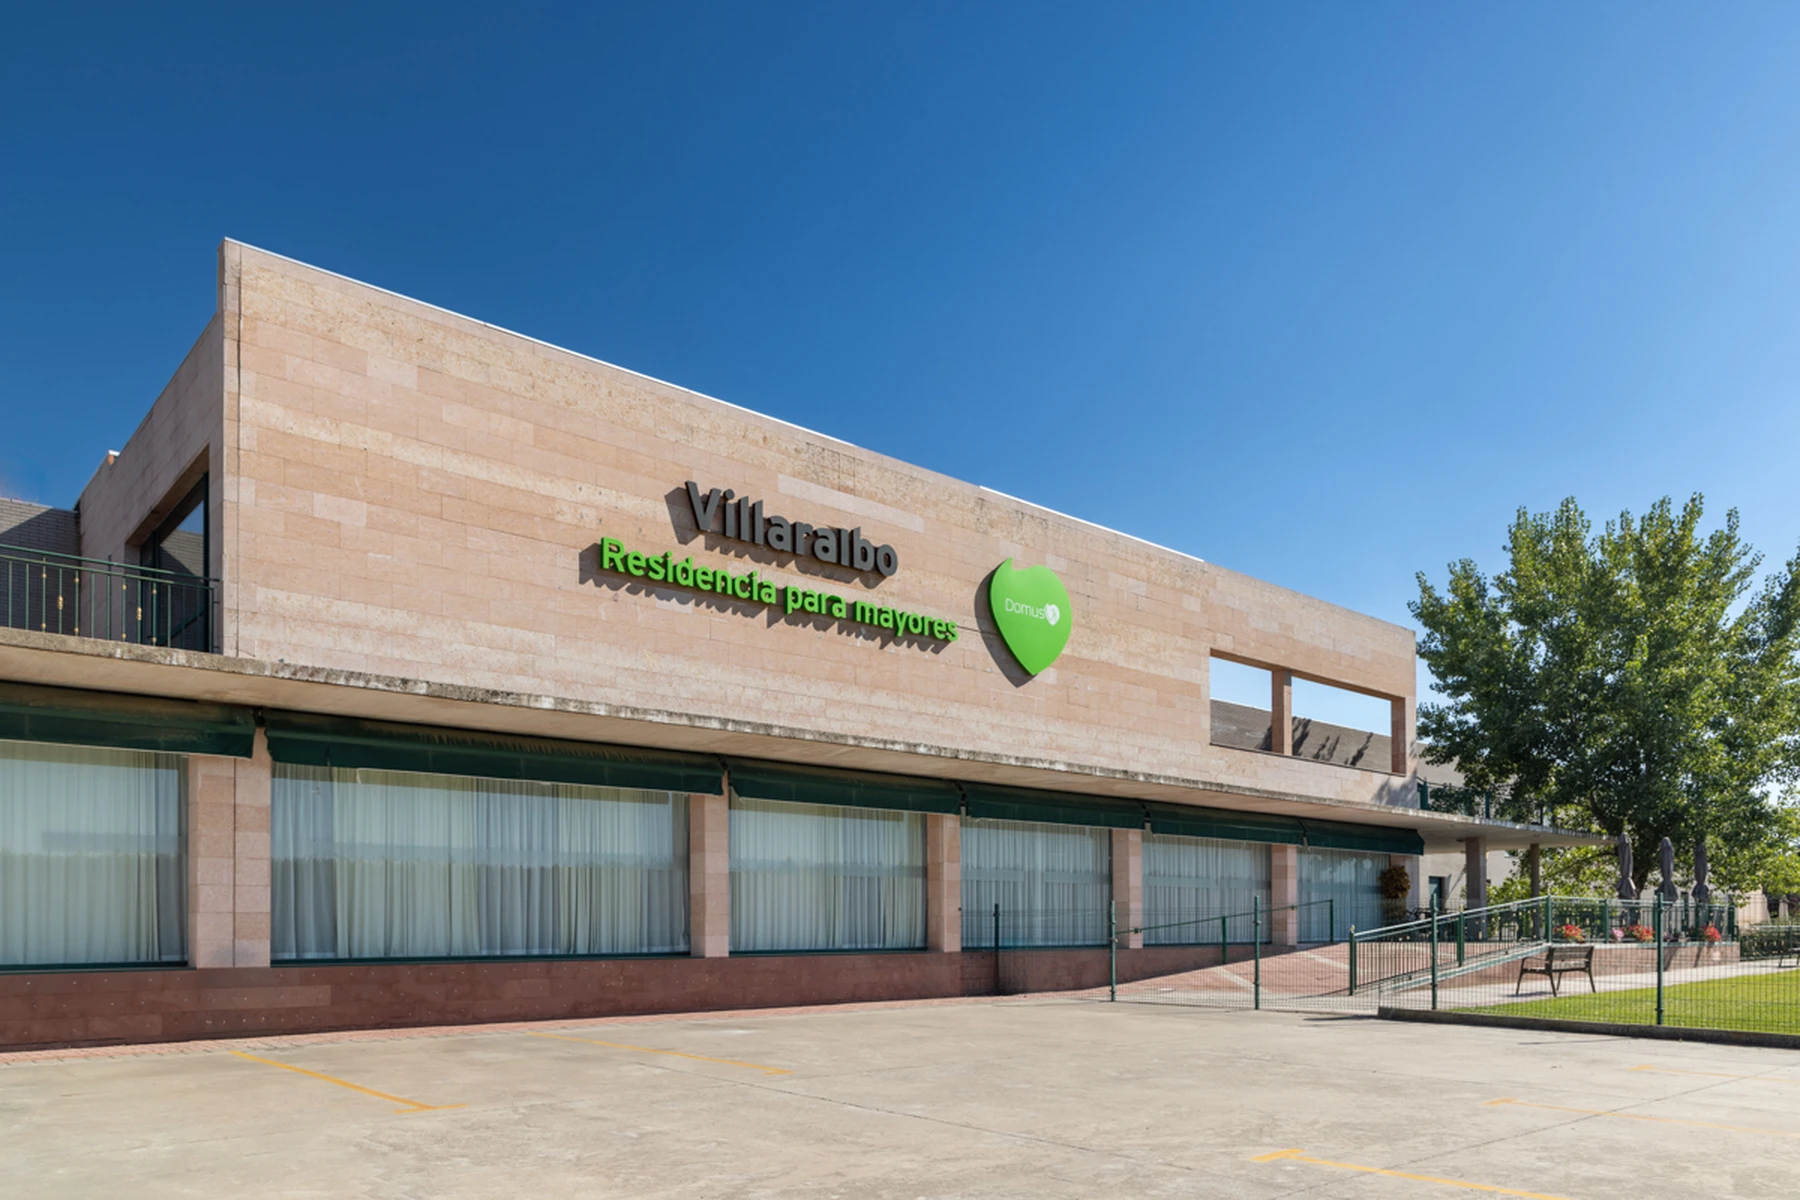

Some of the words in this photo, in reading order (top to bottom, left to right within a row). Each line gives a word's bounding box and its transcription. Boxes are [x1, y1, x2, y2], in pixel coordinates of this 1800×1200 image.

[685, 480, 898, 577] Villaralbo
[601, 536, 777, 605] Residencia
[785, 586, 847, 619] para
[855, 600, 959, 642] mayores
